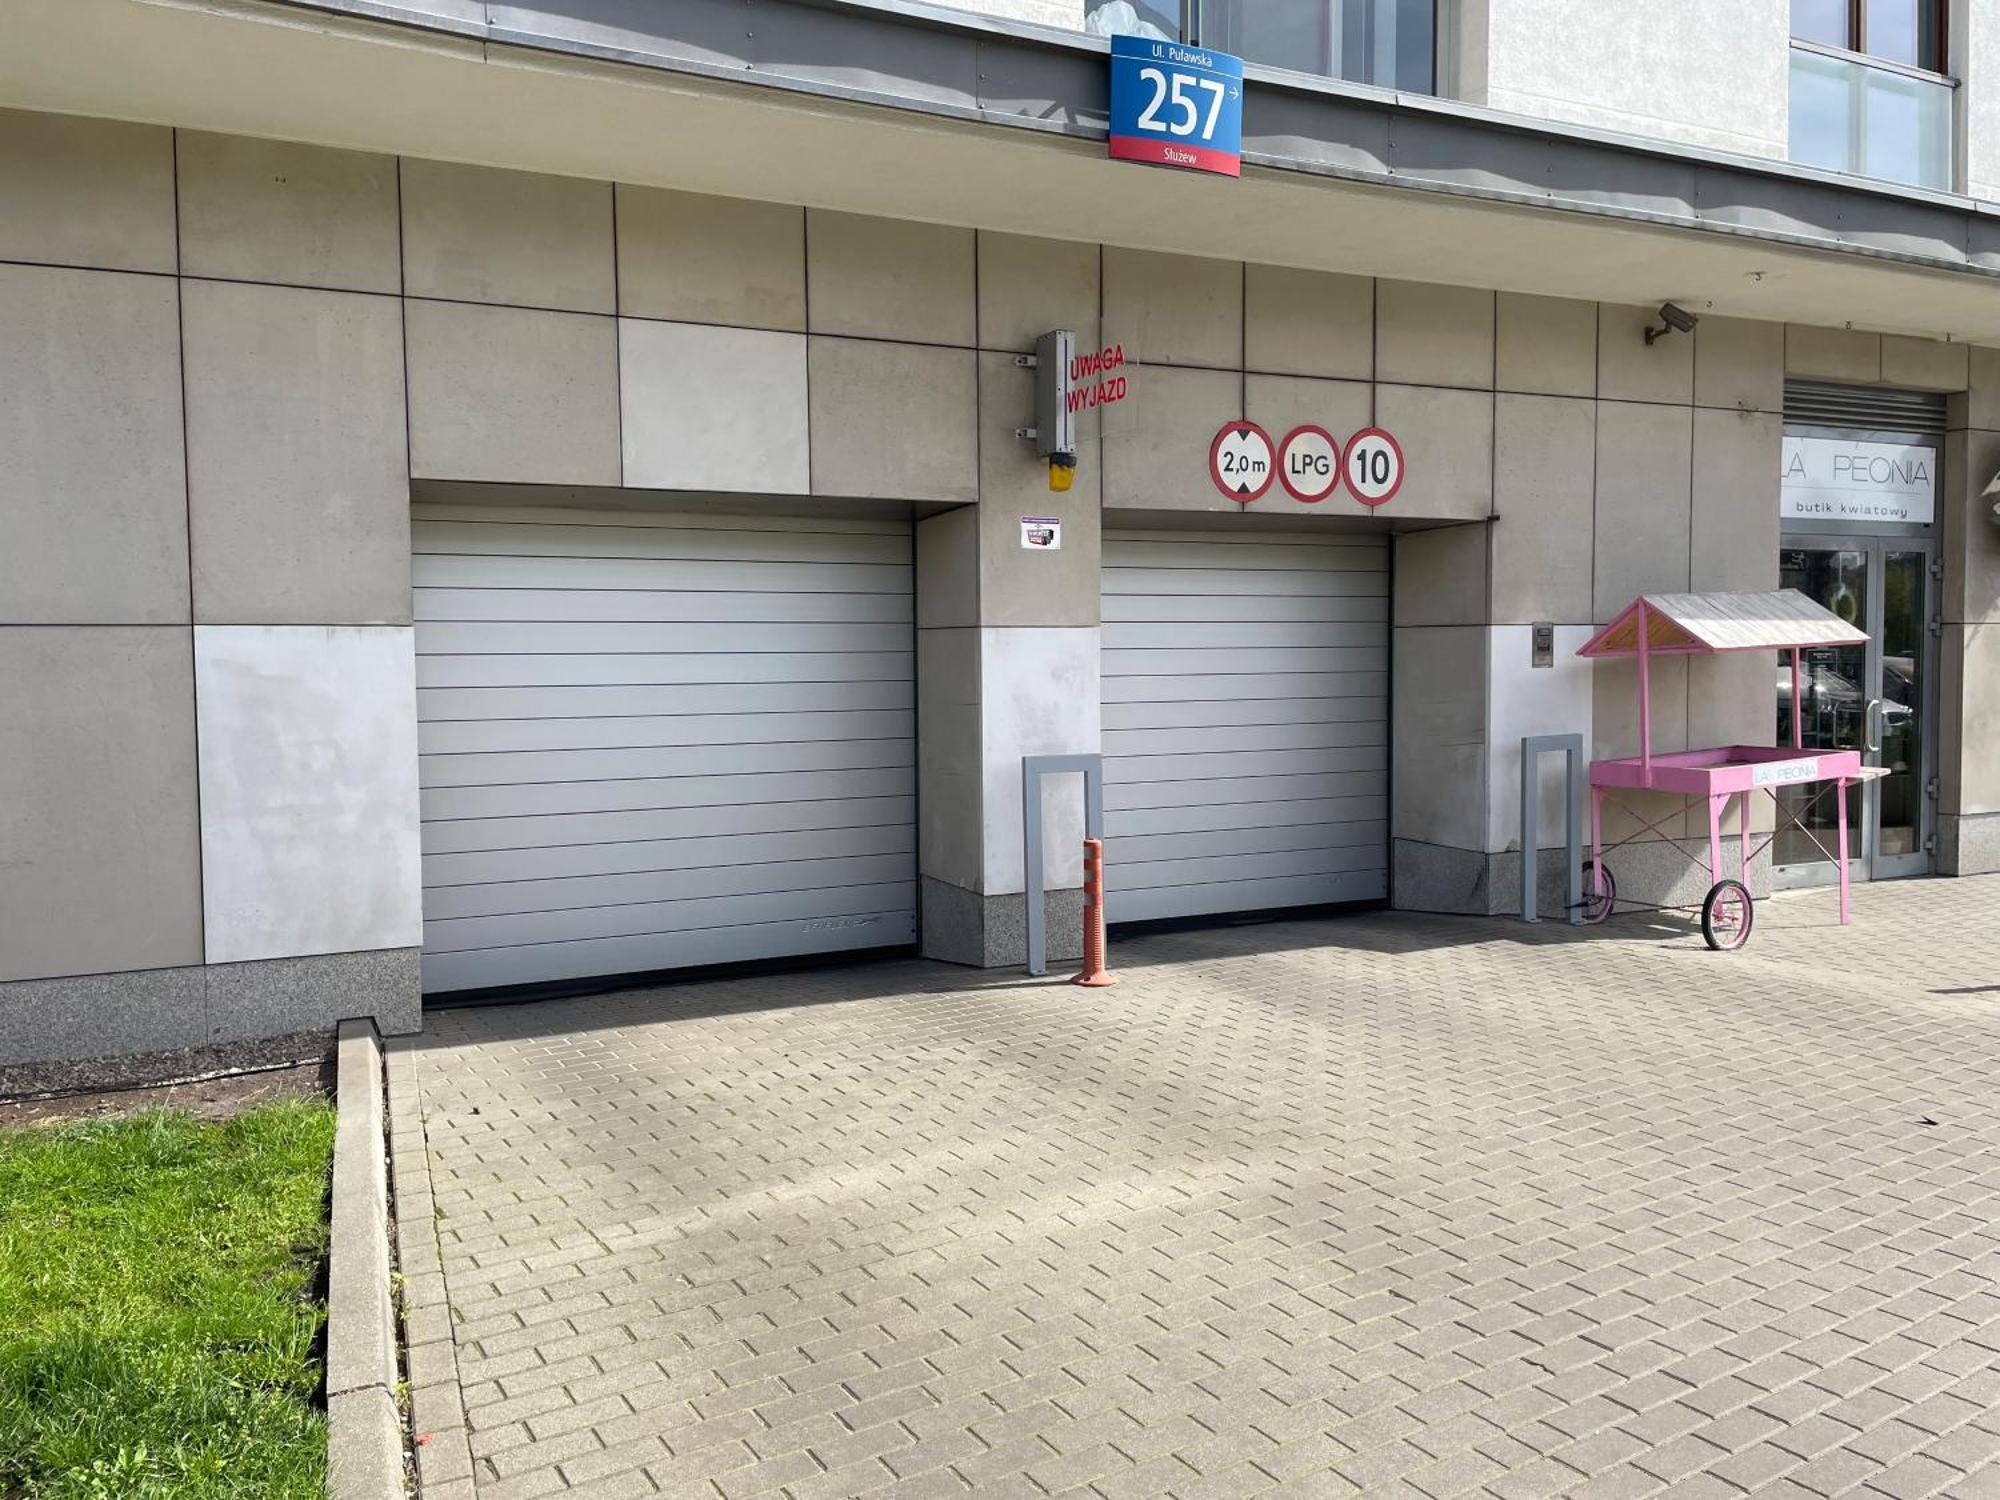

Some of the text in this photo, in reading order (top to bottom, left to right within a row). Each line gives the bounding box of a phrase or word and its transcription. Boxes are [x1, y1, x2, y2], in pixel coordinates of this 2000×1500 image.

[1152, 44, 1213, 67] Ul. Puławska
[1138, 68, 1225, 140] 257
[1164, 147, 1197, 165] Służew
[1070, 344, 1125, 381] UWAGA
[1067, 376, 1127, 413] WYJAZD
[1291, 453, 1330, 476] LPG
[1357, 449, 1390, 485] 10
[1833, 454, 1930, 488] PEONIA
[1796, 502, 1908, 519] butik kwiatowy
